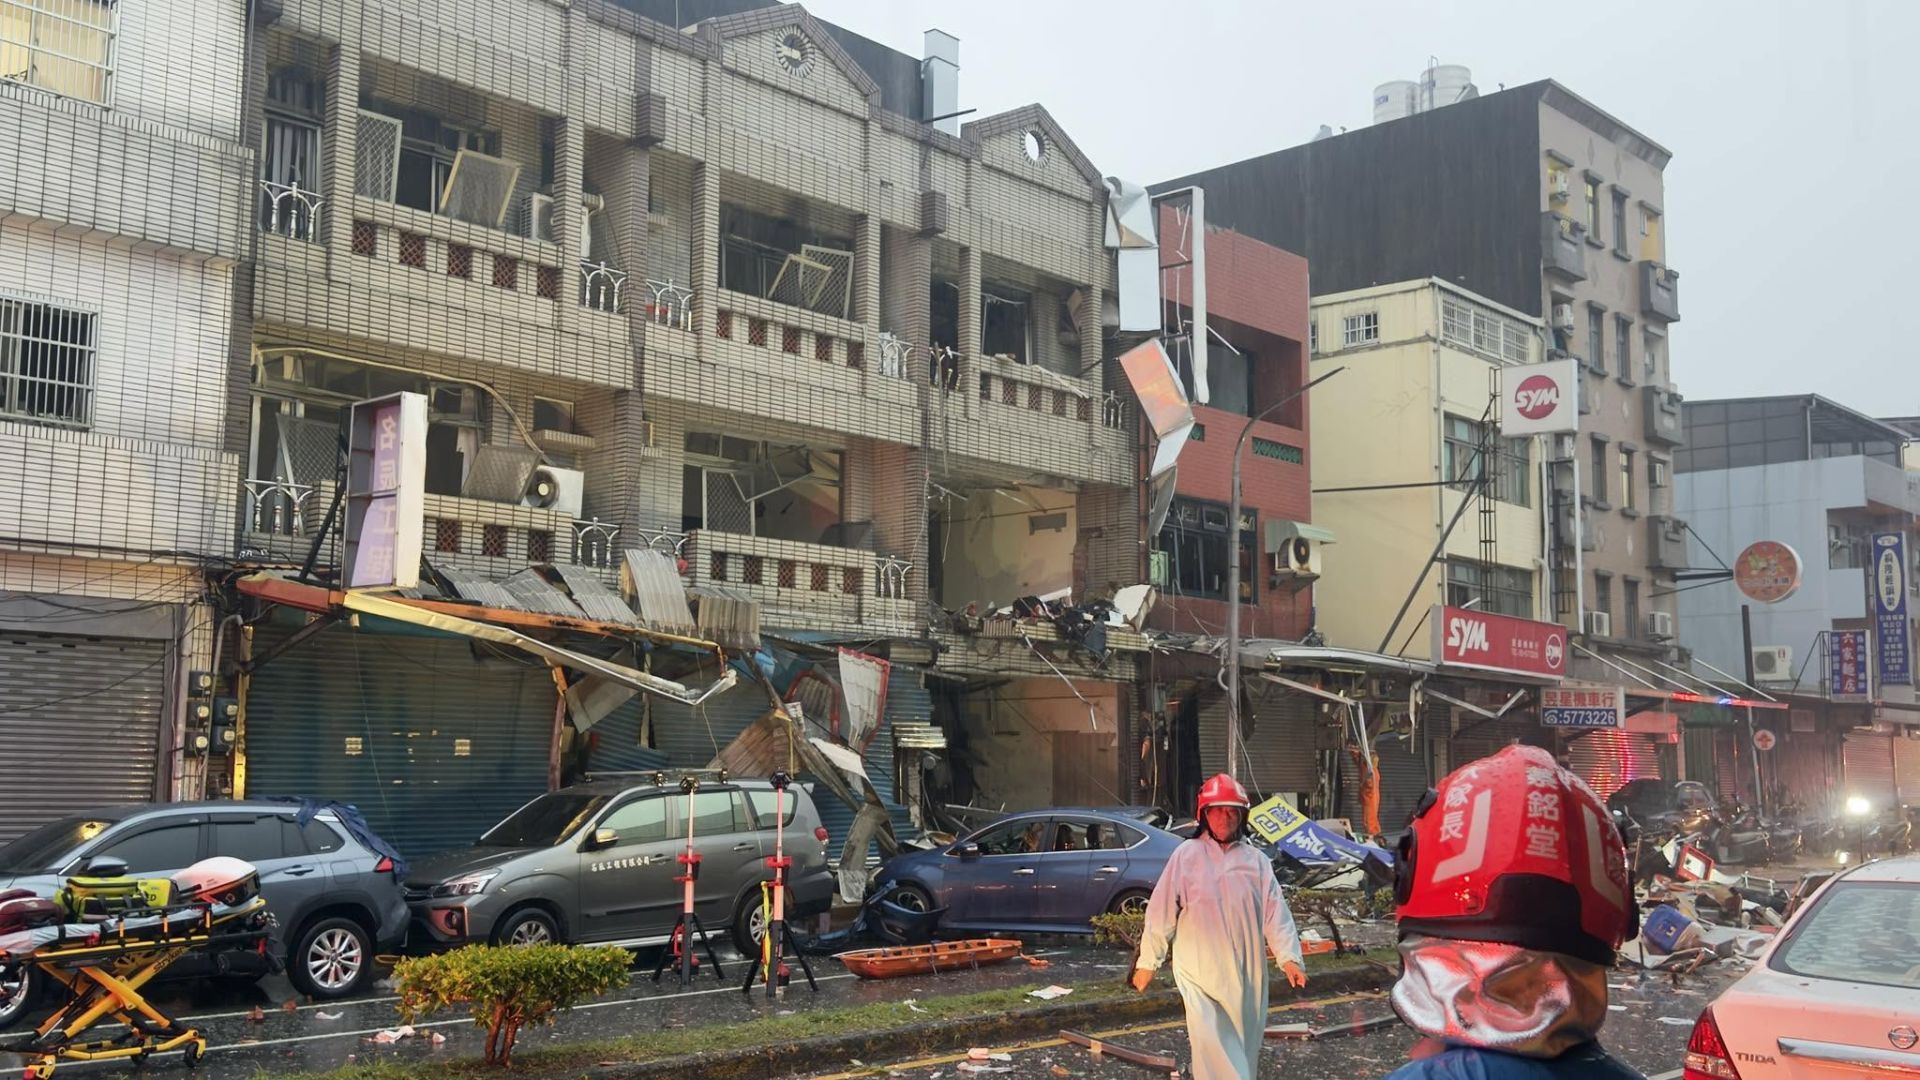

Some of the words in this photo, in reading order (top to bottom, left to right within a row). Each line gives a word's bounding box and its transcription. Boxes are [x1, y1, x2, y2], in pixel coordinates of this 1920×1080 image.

[1515, 387, 1559, 412] SYM
[1447, 617, 1489, 656] SYM
[1544, 690, 1615, 708] 昱星機車行
[1735, 1052, 1777, 1065] TIIDA
